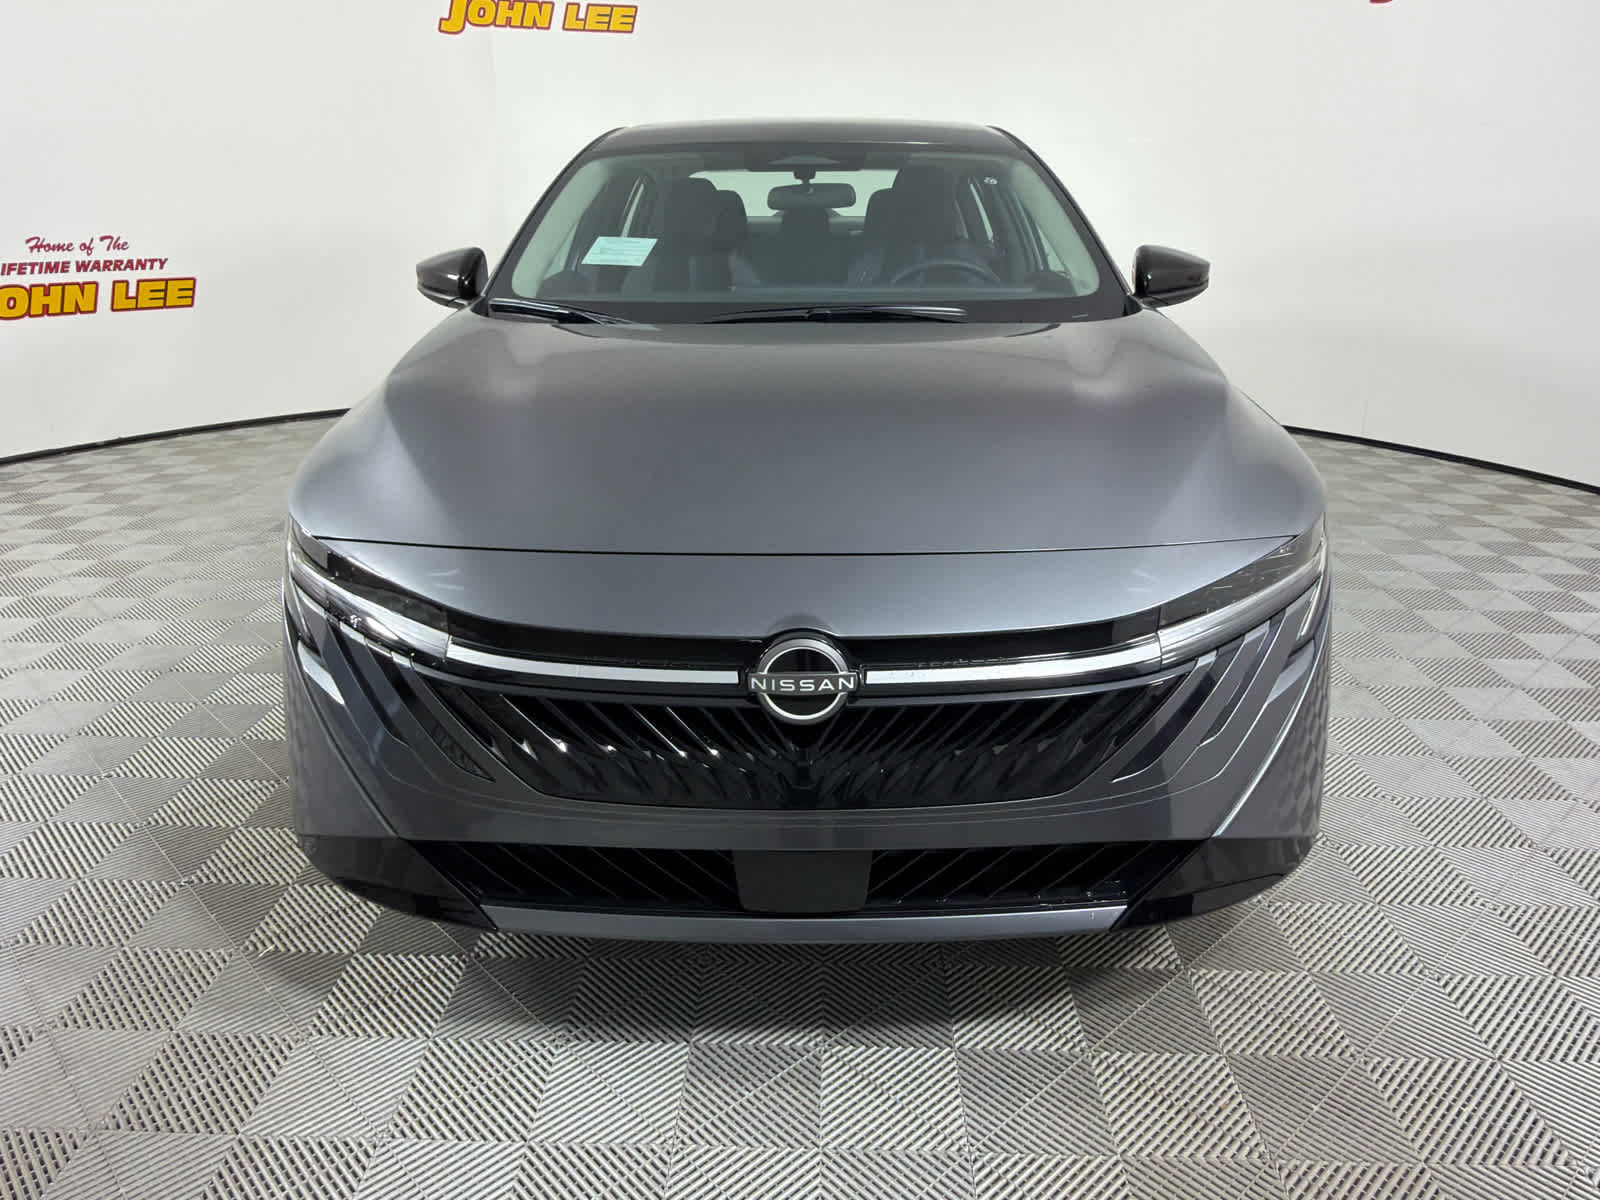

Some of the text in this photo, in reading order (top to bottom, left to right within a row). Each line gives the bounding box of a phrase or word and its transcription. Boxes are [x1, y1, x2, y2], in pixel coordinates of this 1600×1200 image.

[438, 0, 638, 35] JOHN LEE
[25, 235, 129, 256] Home of The
[75, 258, 168, 273] WARRANTY
[110, 276, 196, 312] LEE
[751, 676, 855, 692] NISSAN
